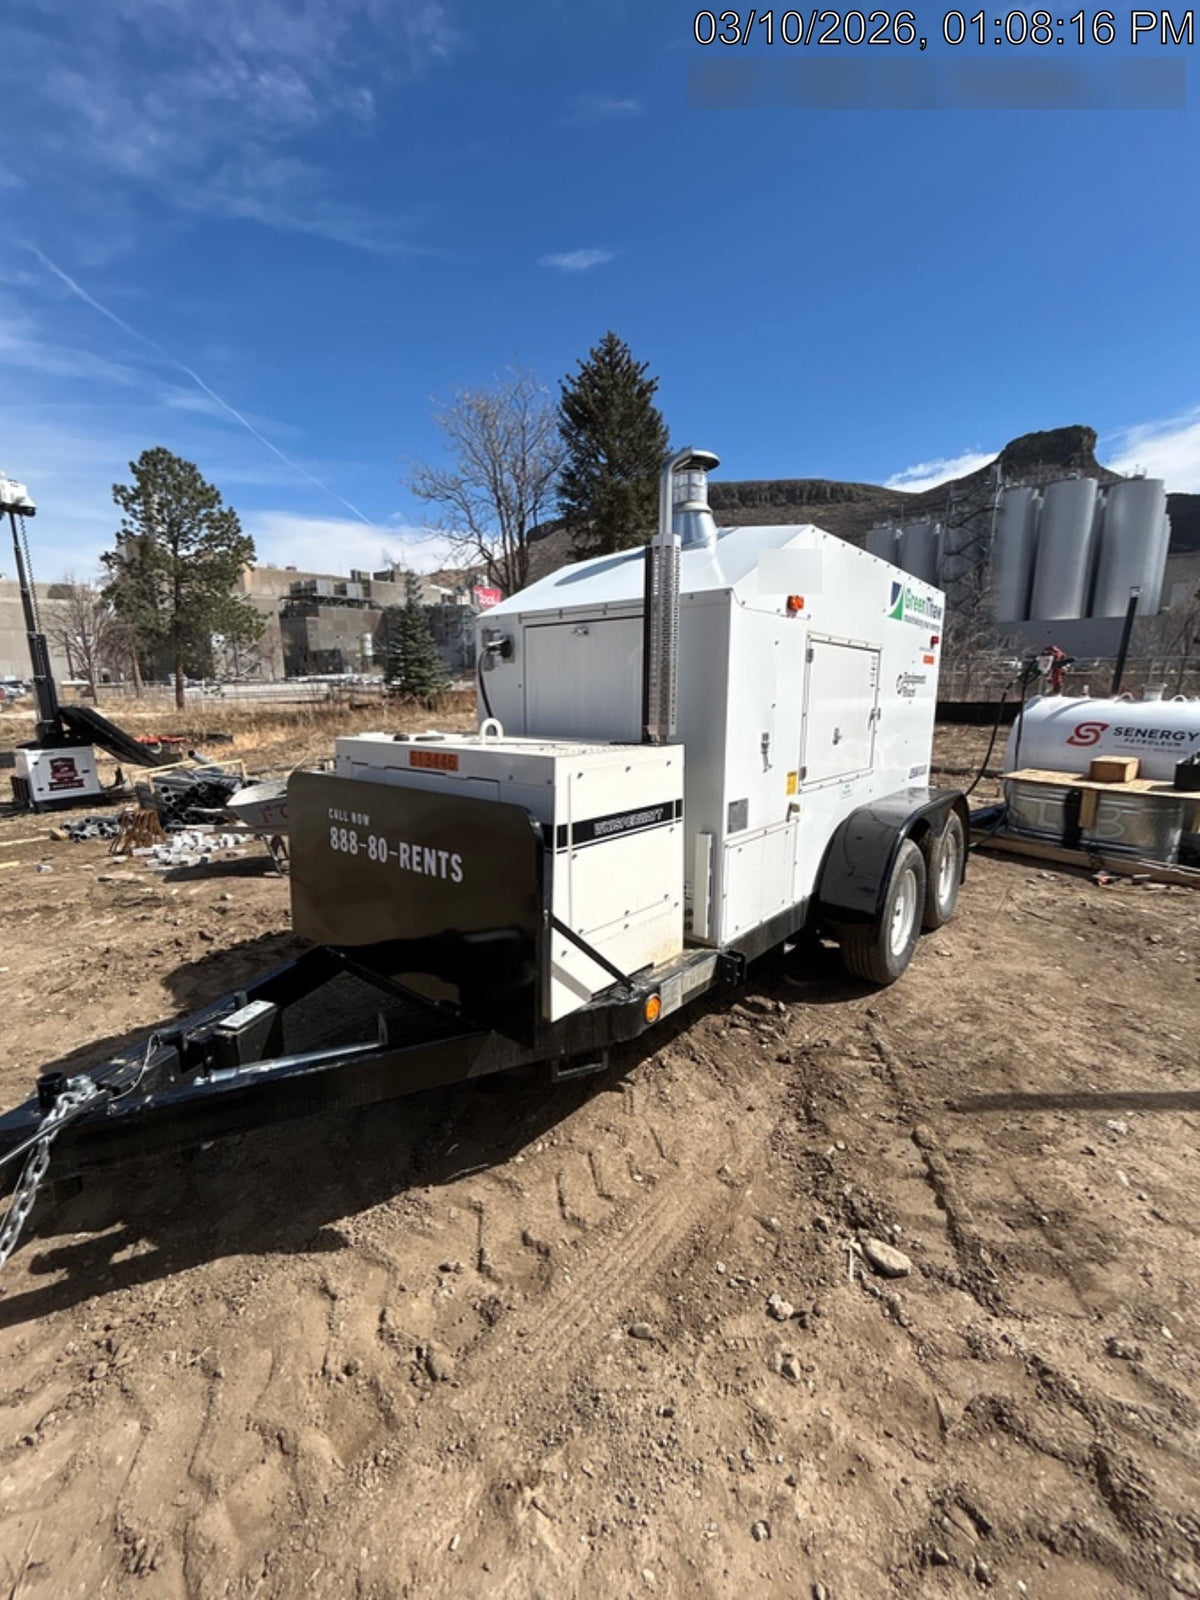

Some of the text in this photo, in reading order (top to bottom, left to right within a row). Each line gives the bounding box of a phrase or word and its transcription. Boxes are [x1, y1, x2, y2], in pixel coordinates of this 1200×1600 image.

[1113, 726, 1200, 743] SENERGY
[328, 807, 370, 827] CALL NOW
[329, 826, 463, 883] 888-80-RENTS
